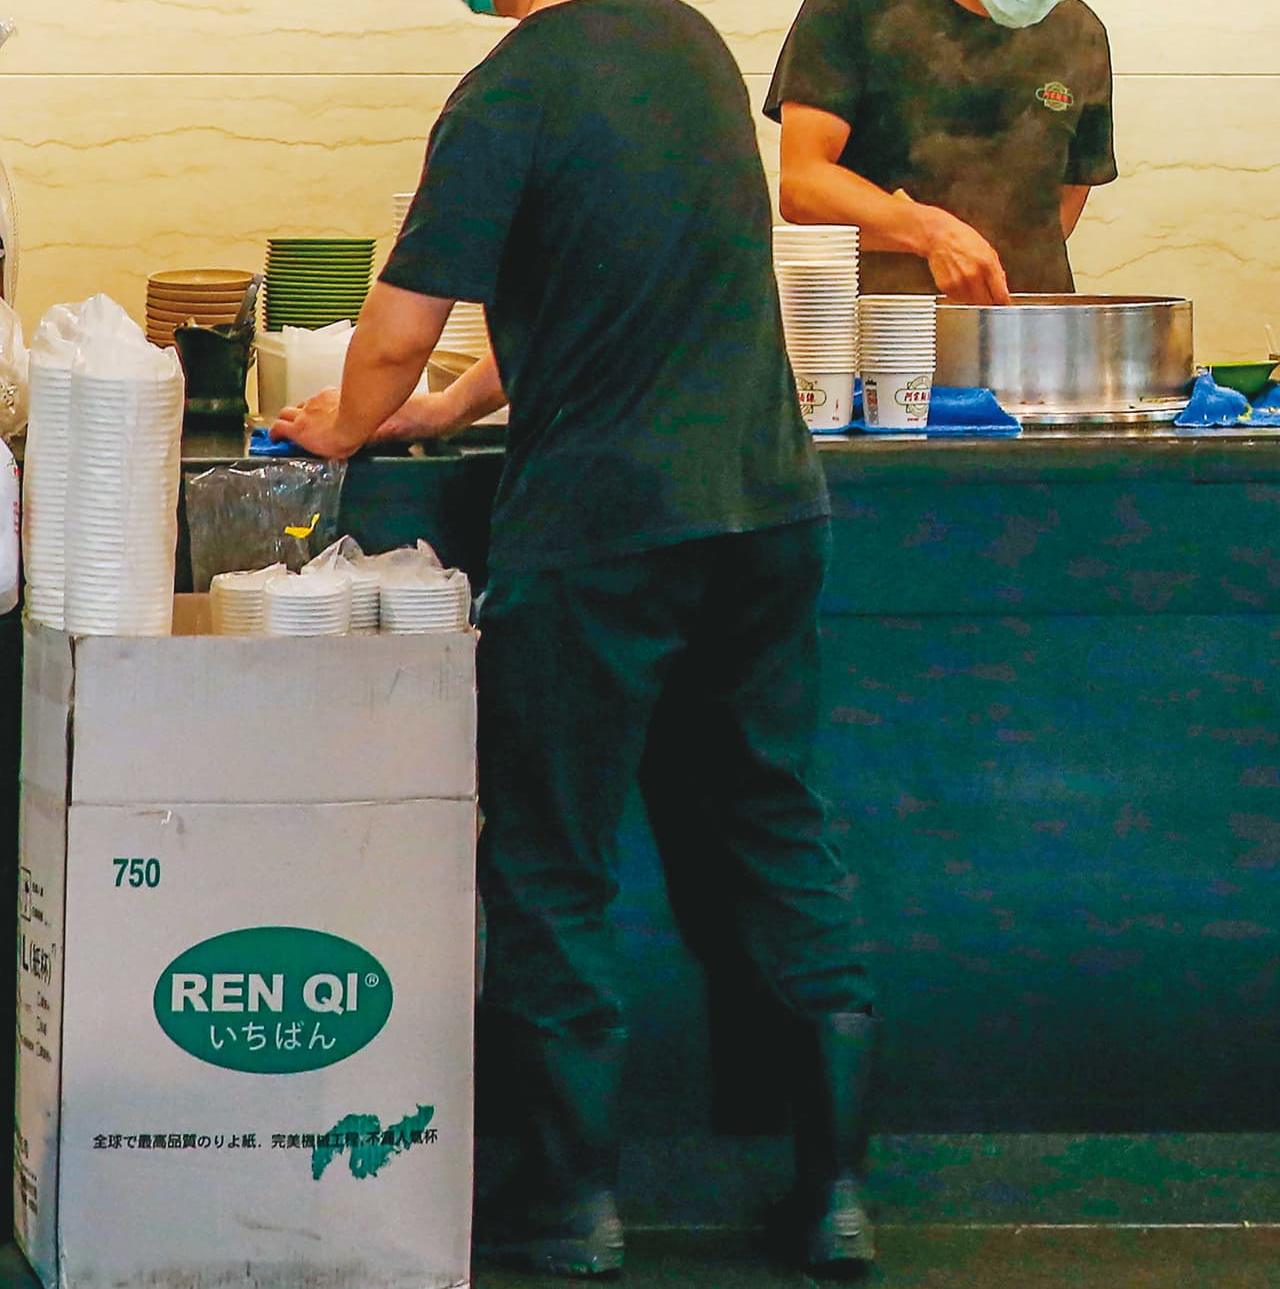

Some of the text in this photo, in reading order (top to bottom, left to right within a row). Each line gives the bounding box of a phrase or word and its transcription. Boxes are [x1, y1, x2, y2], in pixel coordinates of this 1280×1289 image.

[112, 858, 161, 887] 750
[171, 973, 283, 1012] REN
[210, 1023, 336, 1051] いちばん
